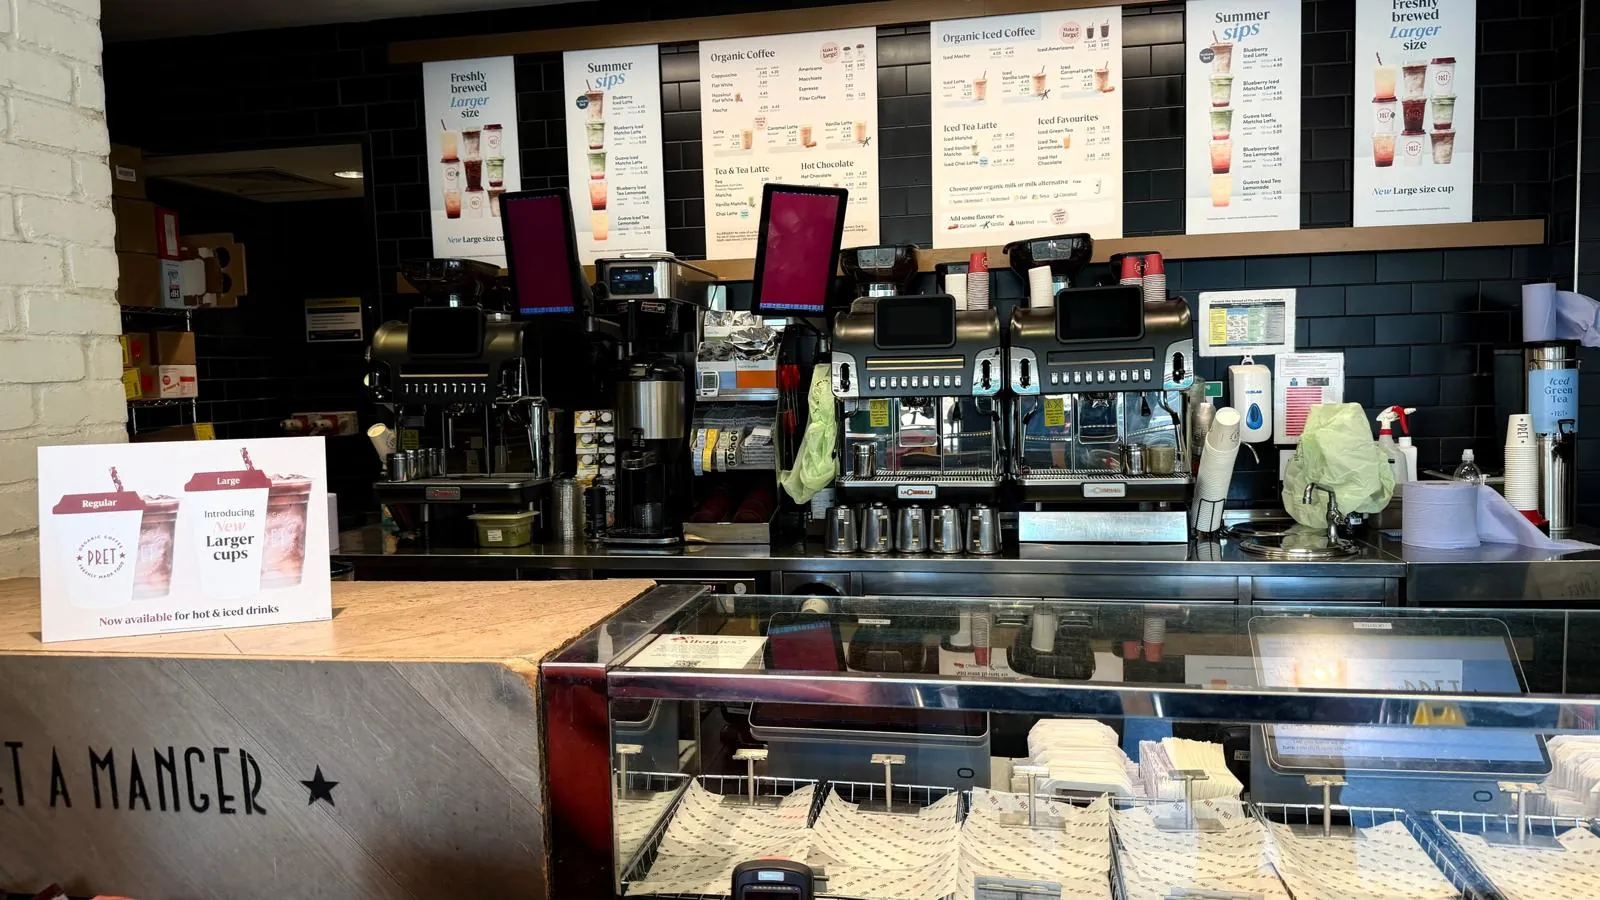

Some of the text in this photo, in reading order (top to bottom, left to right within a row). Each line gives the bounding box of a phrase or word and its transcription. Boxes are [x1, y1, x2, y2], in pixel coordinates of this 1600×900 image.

[1215, 10, 1270, 24] Summer
[1392, 9, 1439, 23] brewed
[943, 27, 1035, 44] Organic Iced Coffee
[1223, 23, 1260, 42] sips
[1390, 26, 1442, 40] Larger
[1403, 40, 1427, 51] size
[711, 49, 775, 63] Organic Coffee
[587, 61, 633, 74] Summer
[451, 71, 487, 84] Freshly
[595, 72, 626, 91] sips
[451, 82, 487, 94] brewed
[450, 95, 490, 110] Larger
[461, 108, 480, 118] size
[1038, 114, 1099, 125] Iced Favourites
[944, 124, 960, 132] Iced
[962, 123, 975, 131] Tea
[801, 160, 854, 170] Hot Chocolate
[1372, 184, 1454, 196] New Large size cup
[447, 236, 462, 245] New
[462, 235, 482, 244] Large
[482, 234, 495, 242] size
[1549, 377, 1570, 385] Iced
[1544, 386, 1573, 395] Green
[1550, 395, 1568, 403] Tea
[216, 476, 241, 486] Large
[82, 498, 118, 508] Regular
[204, 508, 255, 519] Introducing
[213, 520, 246, 532] New
[206, 534, 255, 548] Larger
[87, 548, 116, 566] PRET
[213, 548, 249, 563] cups
[99, 604, 279, 627] Now available for hot & iced drinks
[50, 745, 72, 808] A
[88, 745, 267, 815] MANGER
